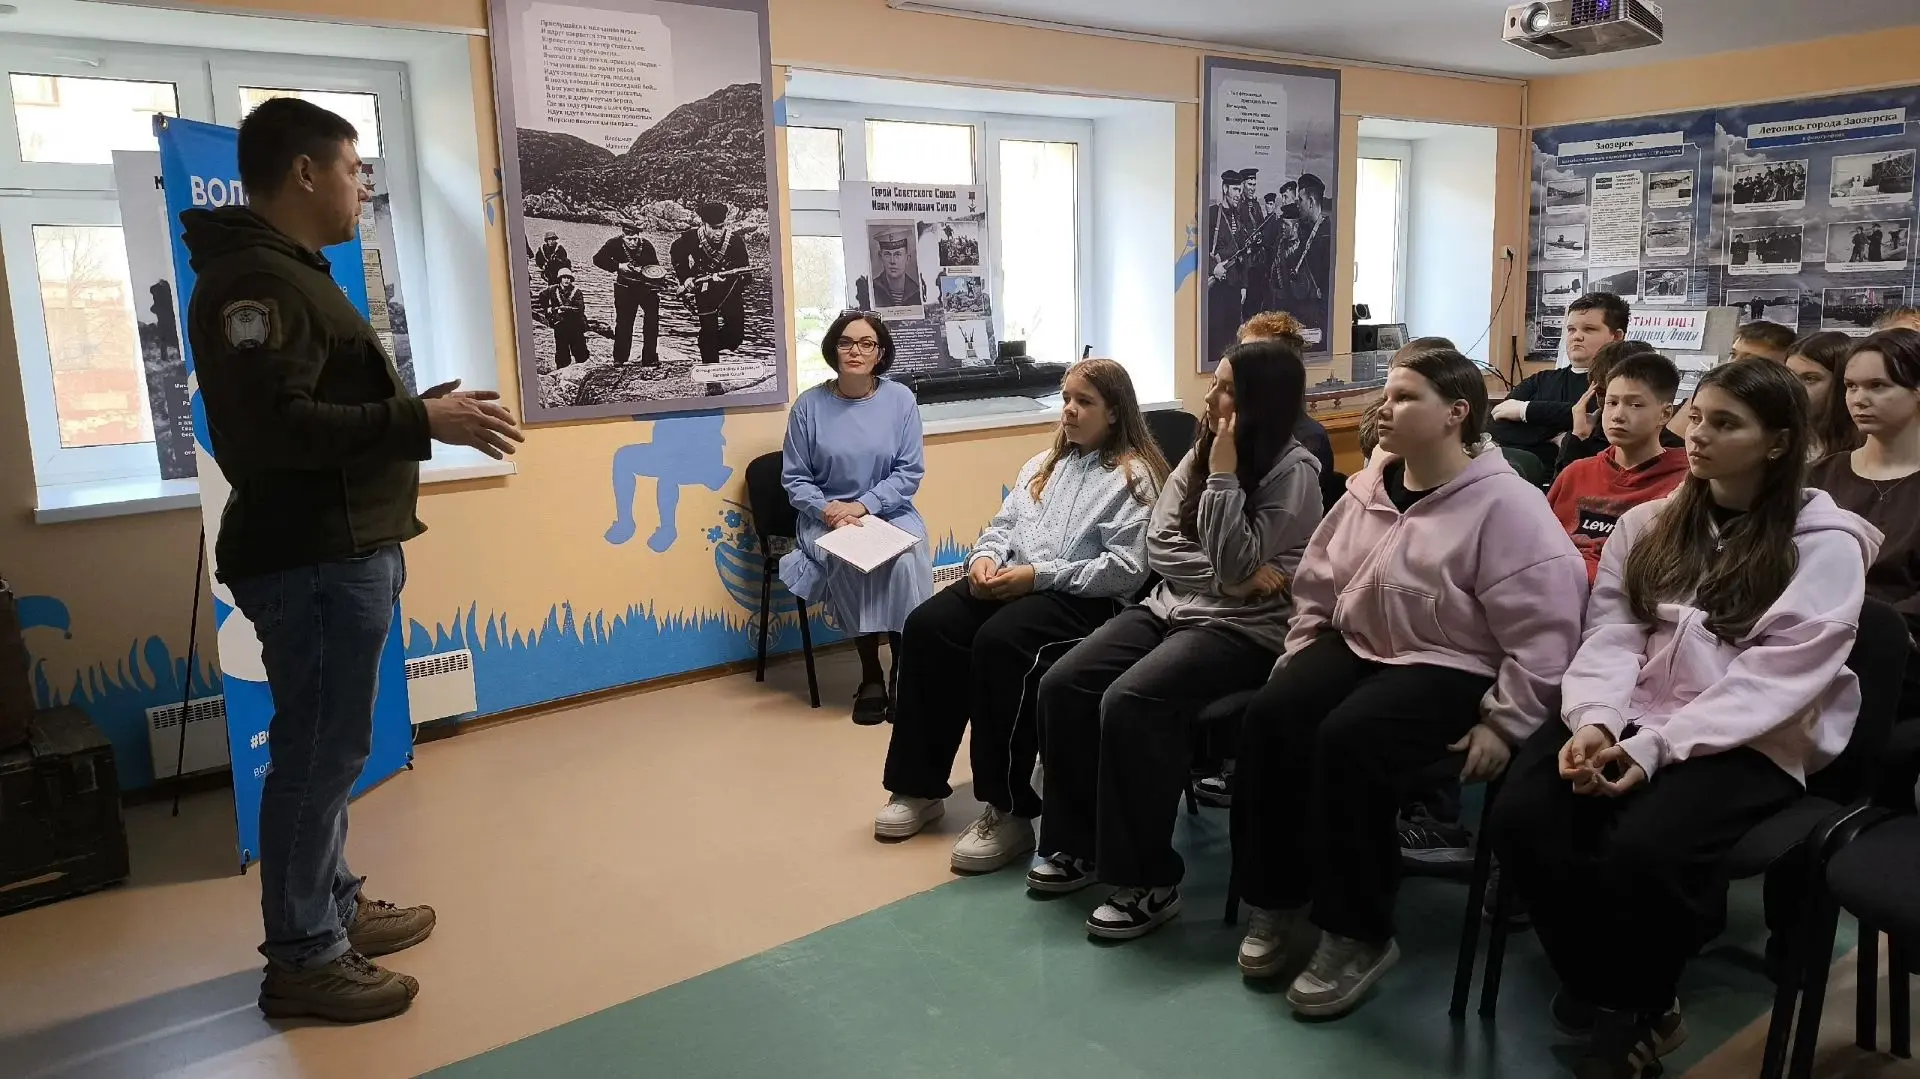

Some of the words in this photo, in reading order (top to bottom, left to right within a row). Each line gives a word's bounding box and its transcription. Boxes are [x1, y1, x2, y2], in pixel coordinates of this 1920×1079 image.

[1758, 125, 1805, 135] Летопись
[1806, 120, 1841, 131] города
[1843, 113, 1898, 126] Заозерска
[1595, 140, 1634, 150] Заозерск
[190, 176, 249, 207] ВОЛ
[251, 730, 269, 749] #В
